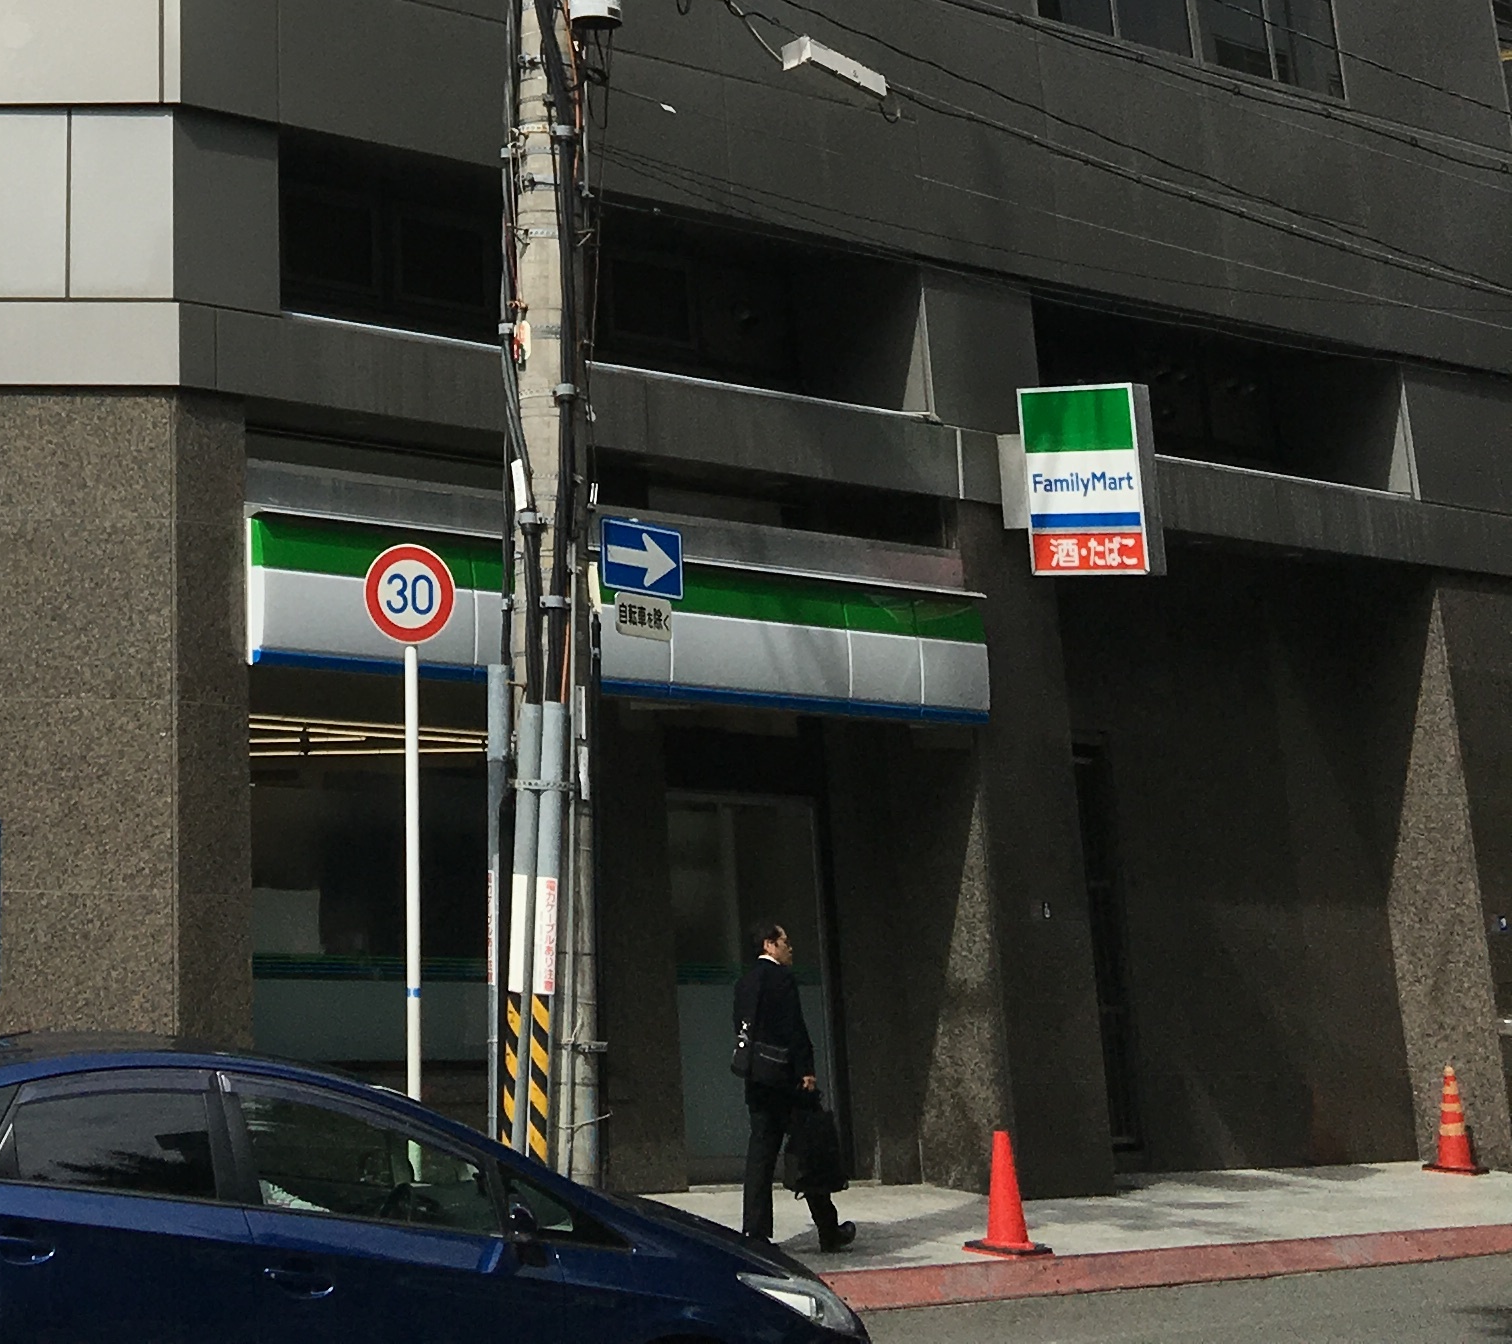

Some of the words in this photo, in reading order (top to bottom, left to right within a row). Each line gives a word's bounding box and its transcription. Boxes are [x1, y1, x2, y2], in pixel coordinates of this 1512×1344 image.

[1032, 471, 1134, 497] FamilyMart
[1049, 536, 1138, 567] 酒・たばこ
[386, 571, 433, 616] 30
[619, 602, 671, 631] 自転車を除く
